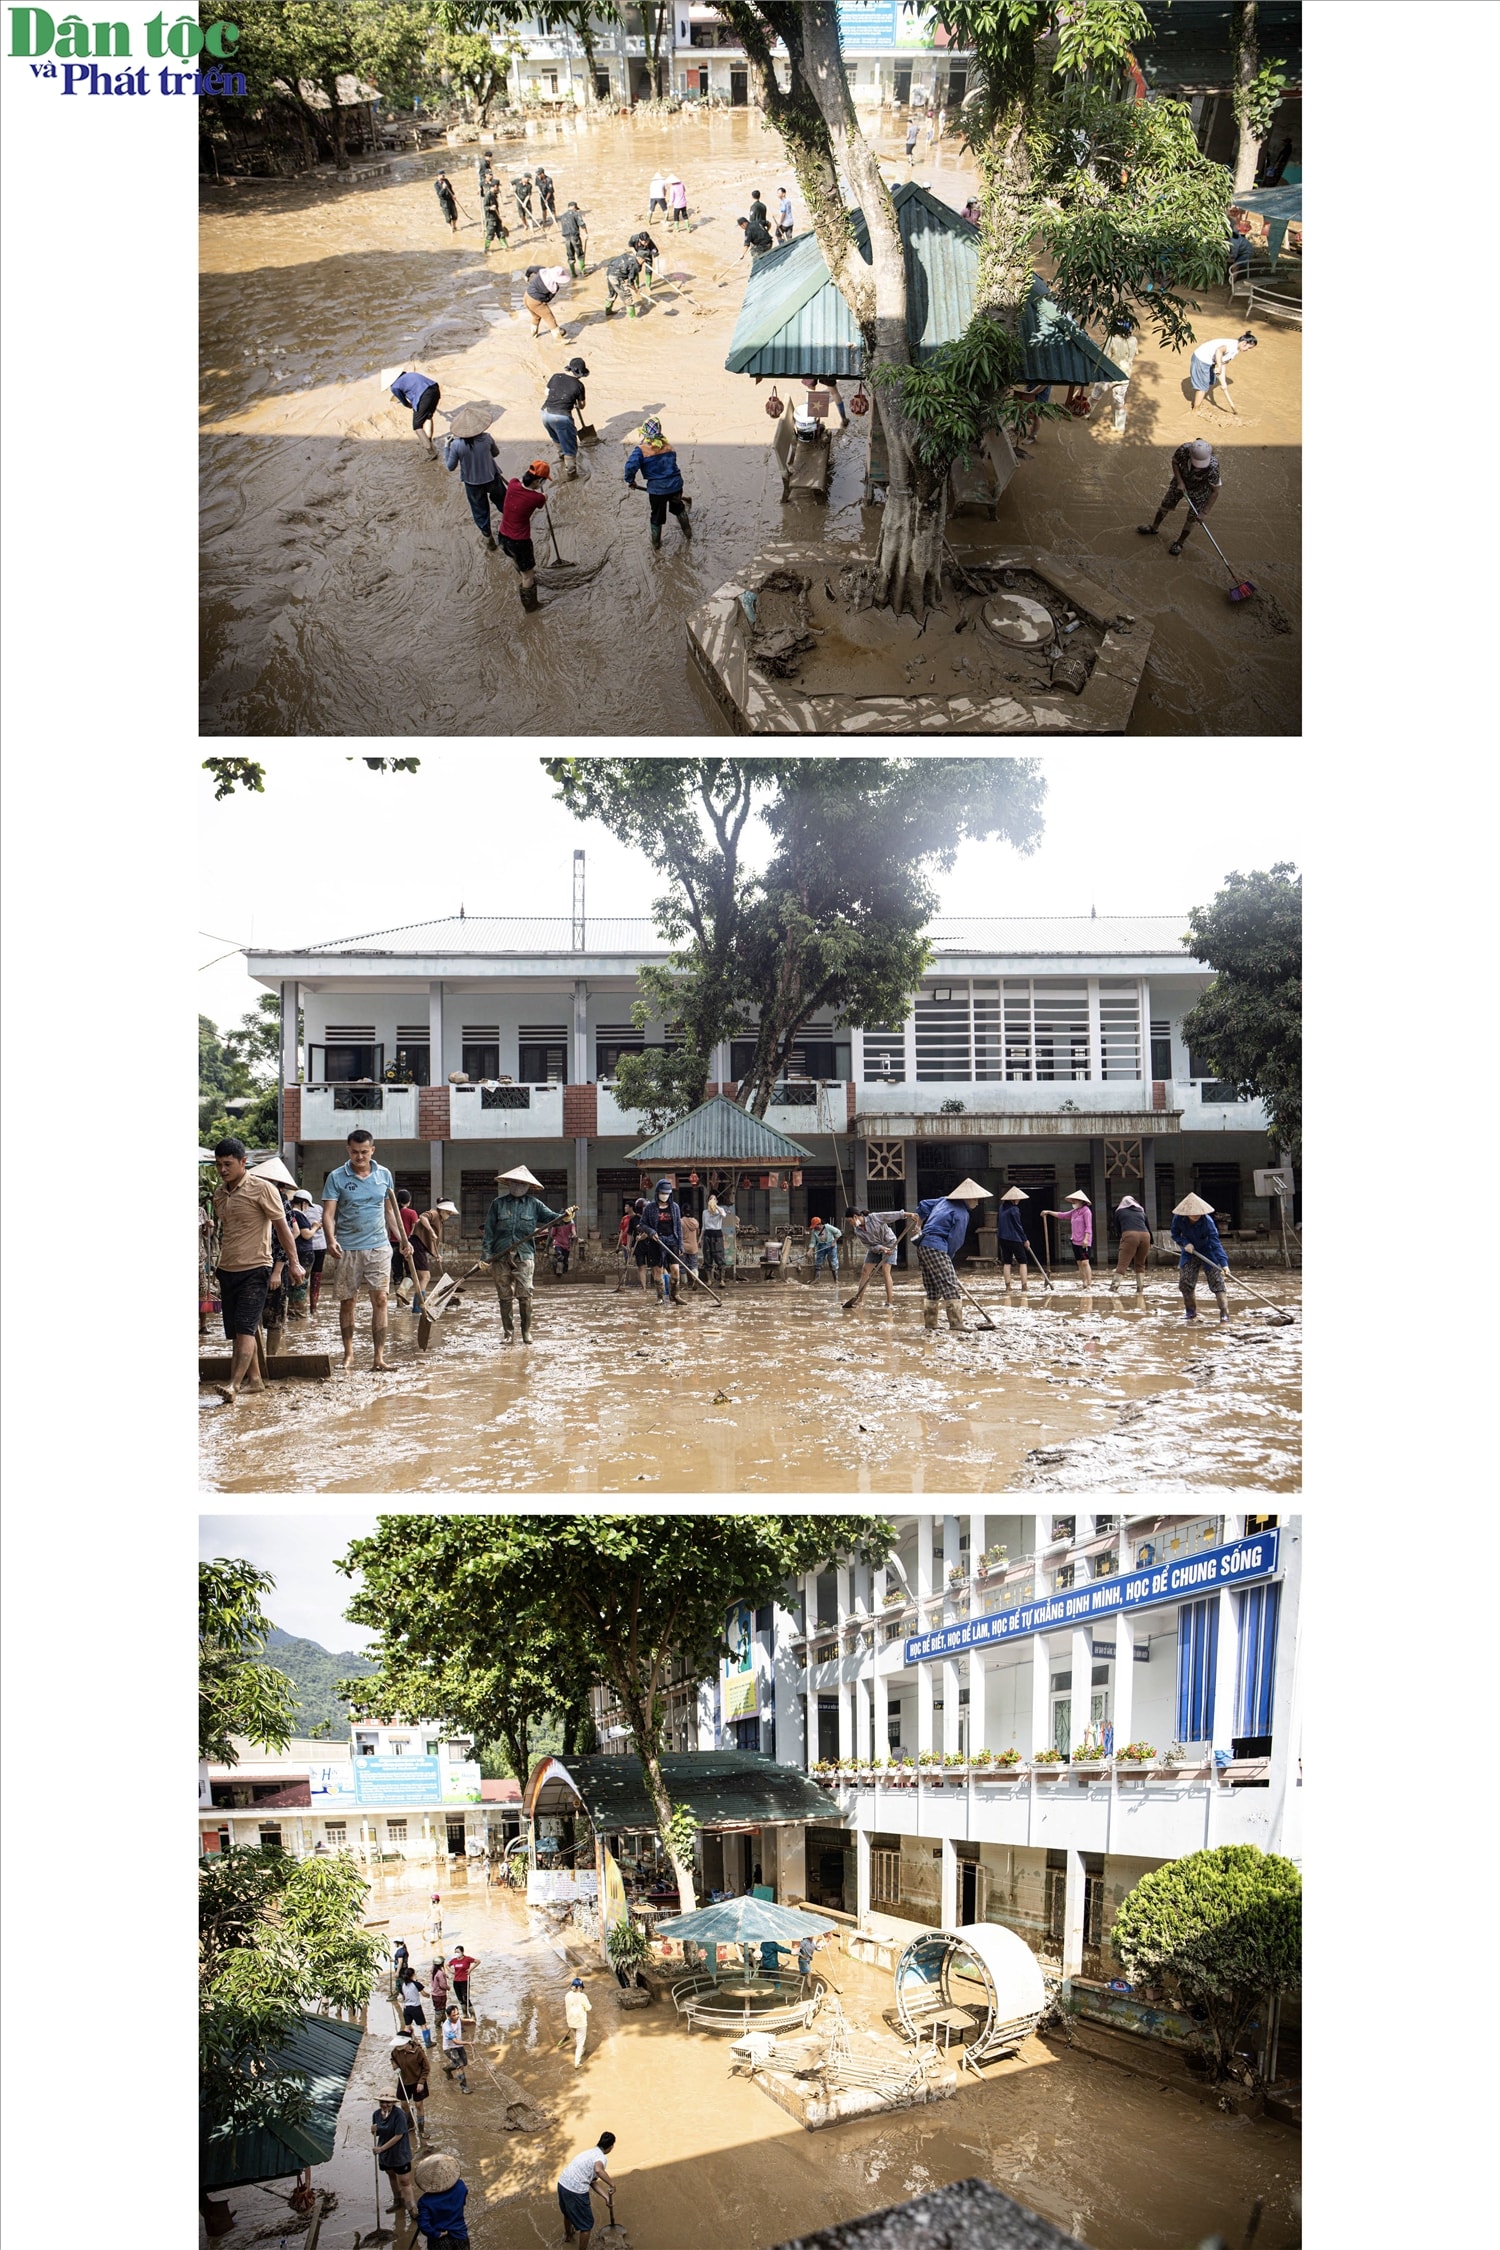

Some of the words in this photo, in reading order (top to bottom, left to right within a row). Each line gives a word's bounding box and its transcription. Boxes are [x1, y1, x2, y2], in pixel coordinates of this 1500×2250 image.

[909, 1643, 922, 1658] HỌC
[931, 1632, 947, 1651] BIẾT,
[947, 1633, 961, 1649] HỌC
[973, 1622, 991, 1641] LÀM,
[991, 1617, 1008, 1637] HỌC
[1009, 1607, 1021, 1631] ĐỂ
[1021, 1608, 1034, 1630] TỰ
[1066, 1595, 1090, 1619] ĐỊNH
[1092, 1584, 1123, 1610] MÌNH,
[1126, 1577, 1149, 1603] HỌC
[1152, 1565, 1170, 1594] ĐỂ
[1171, 1559, 1217, 1589] CHUNG
[1220, 1544, 1263, 1576] SỐNG
